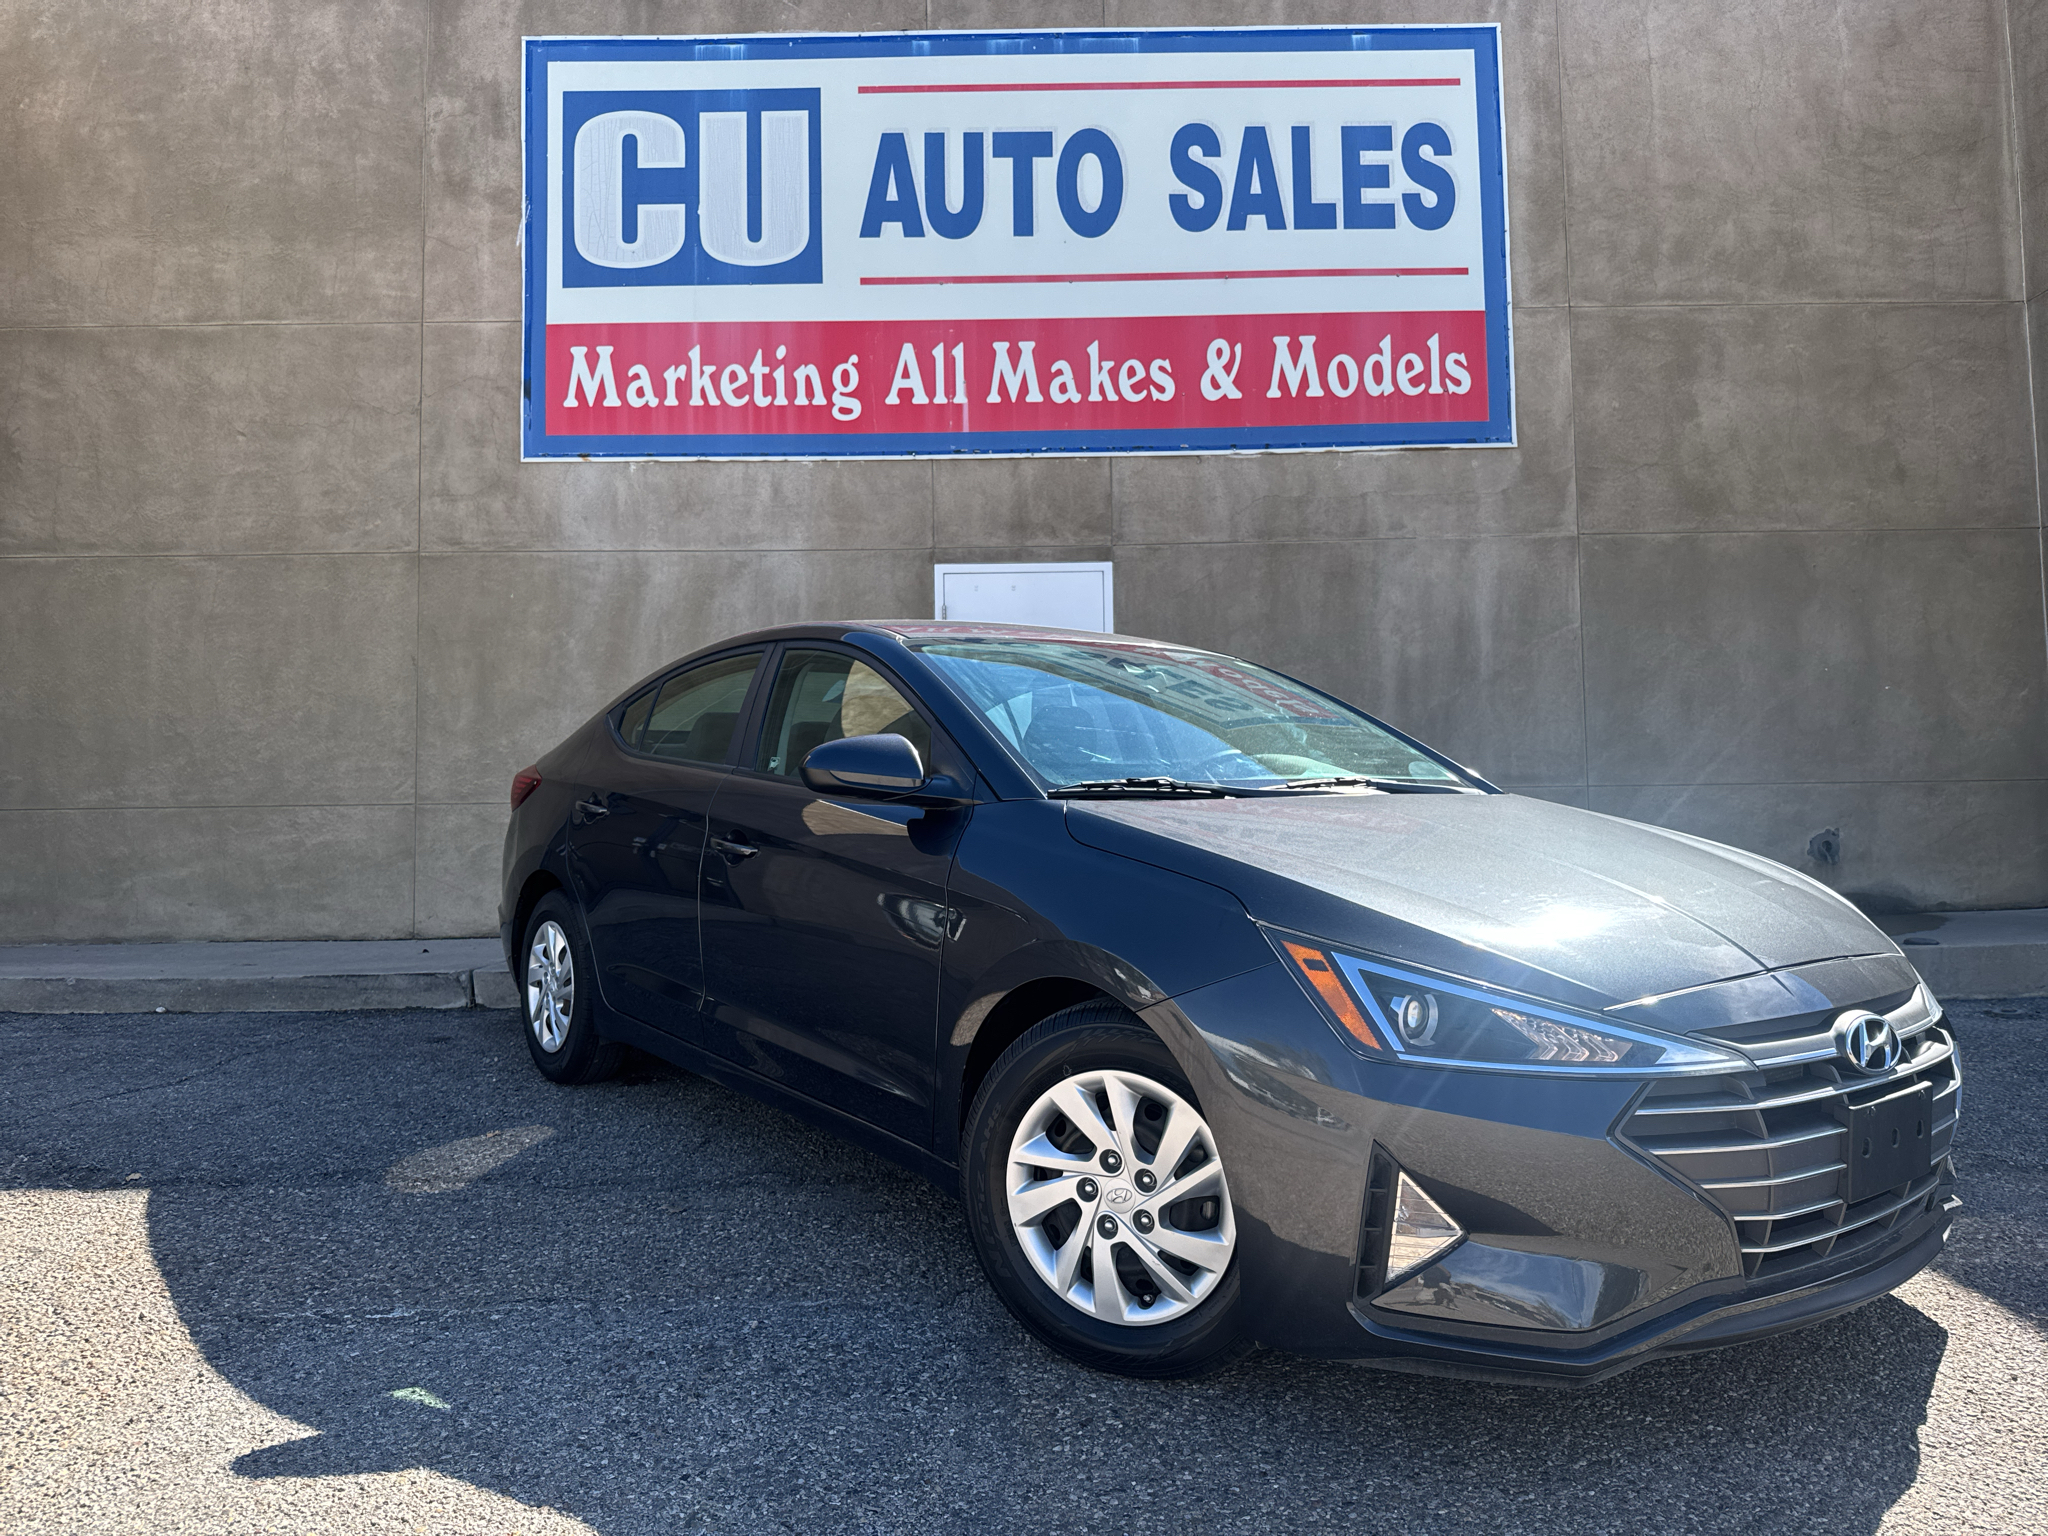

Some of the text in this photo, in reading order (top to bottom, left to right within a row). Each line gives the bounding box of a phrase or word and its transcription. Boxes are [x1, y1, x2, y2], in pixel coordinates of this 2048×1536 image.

[573, 109, 1456, 269] CU AUTO SALES
[563, 333, 1472, 422] Marketing All Makes & Models
